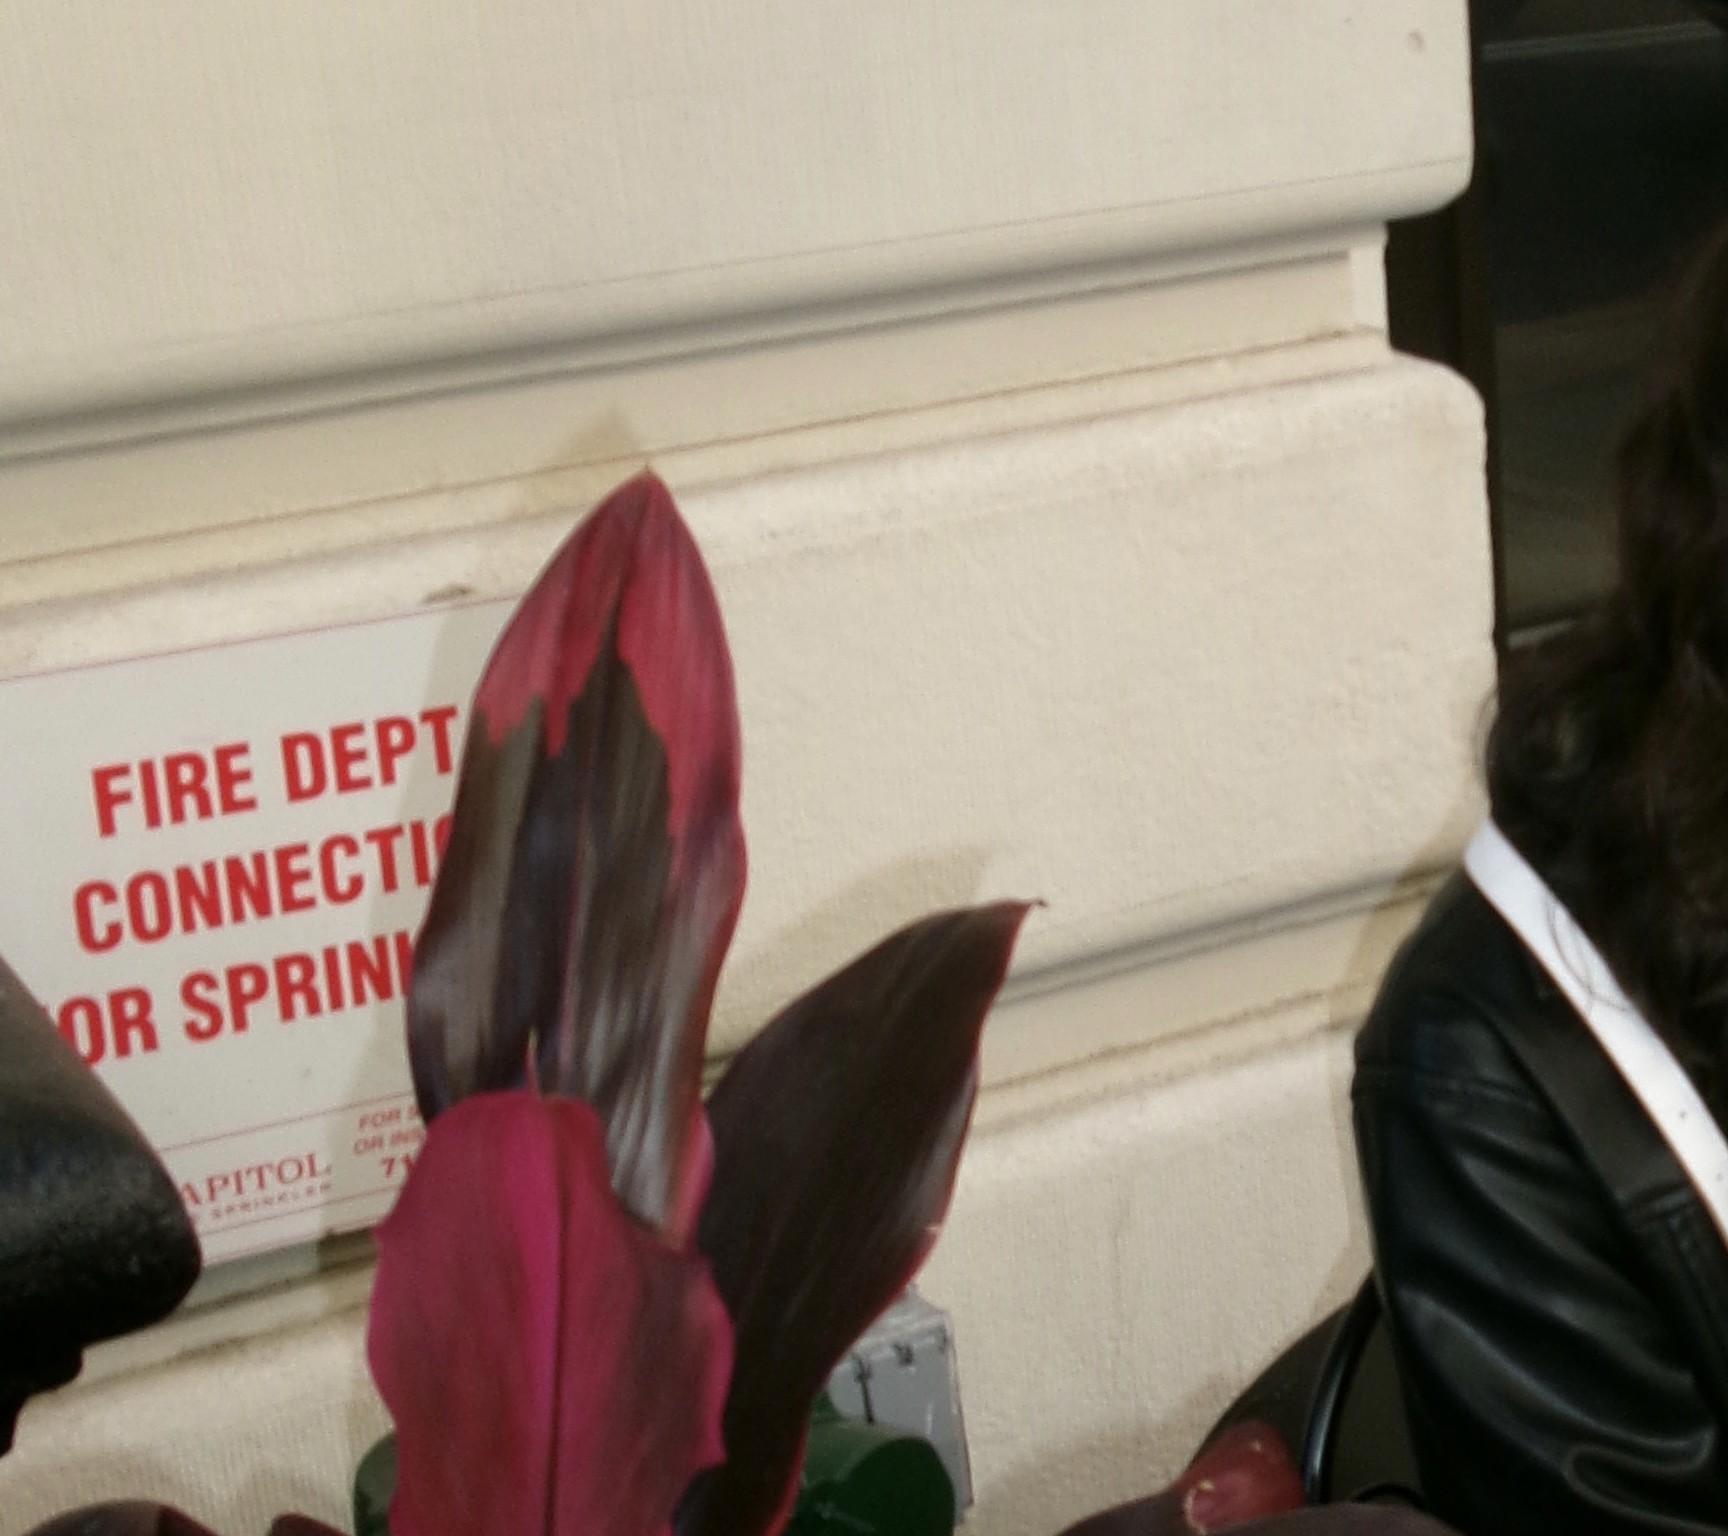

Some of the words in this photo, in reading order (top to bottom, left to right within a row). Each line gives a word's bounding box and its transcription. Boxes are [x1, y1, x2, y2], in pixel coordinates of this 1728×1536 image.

[90, 739, 258, 839] FIRE
[279, 703, 459, 806] DEPT
[72, 811, 455, 956] CONNECTI
[41, 985, 160, 1069] OR
[178, 929, 415, 1044] SPRIN
[179, 1151, 333, 1207] APITOL
